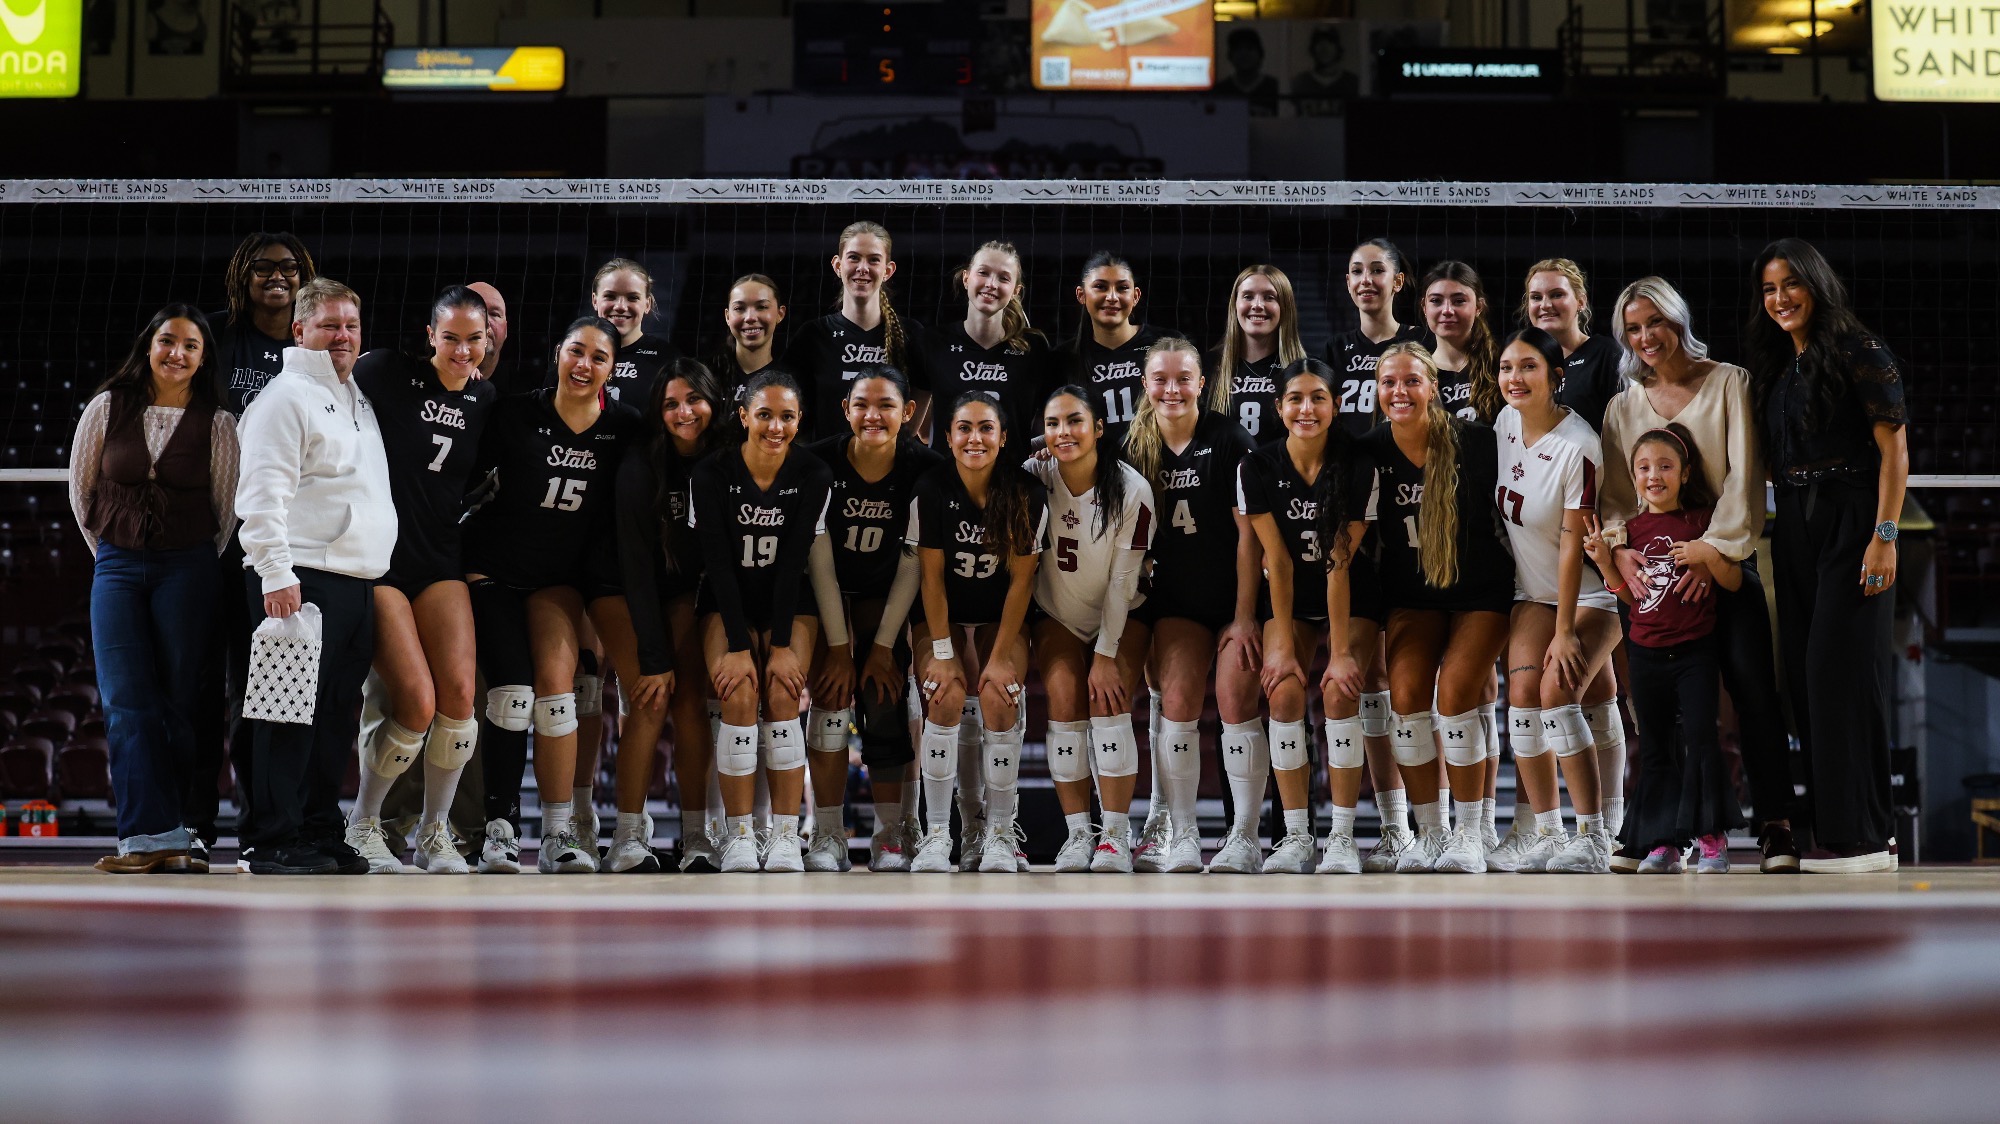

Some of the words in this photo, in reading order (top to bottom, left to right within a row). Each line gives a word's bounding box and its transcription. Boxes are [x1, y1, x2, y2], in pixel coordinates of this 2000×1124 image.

[879, 58, 895, 83] 5
[1421, 63, 1473, 77] UNDER
[1474, 63, 1541, 77] ARMOUR
[77, 184, 118, 194] WHITE
[127, 184, 168, 194] SANDS
[239, 184, 282, 194] WHITE
[290, 182, 332, 193] SANDS
[402, 184, 444, 194] WHITE
[454, 182, 494, 193] SANDS
[567, 184, 610, 194] WHITE
[619, 184, 662, 194] SANDS
[734, 184, 778, 194] WHITE
[785, 184, 828, 194] SANDS
[900, 184, 942, 194] WHITE
[951, 184, 994, 195] SANDS
[1067, 184, 1110, 195] WHITE
[1233, 186, 1276, 196] WHITE
[1284, 186, 1326, 196] SANDS
[1397, 186, 1440, 197] WHITE
[1449, 186, 1490, 197] SANDS
[1563, 188, 1604, 198] WHITE
[1613, 188, 1654, 199] SANDS
[1726, 188, 1768, 199] WHITE
[1776, 190, 1816, 200] SANDS
[1887, 190, 1928, 201] WHITE
[1937, 192, 1978, 202] SANDS
[960, 361, 1008, 382] State
[1092, 361, 1141, 383] State
[1346, 354, 1377, 372] Sta
[1230, 376, 1276, 394] State
[1442, 383, 1470, 404] Sta
[1103, 387, 1136, 424] 11
[1340, 379, 1376, 413] 28
[421, 400, 465, 429] State
[1239, 401, 1260, 436] 8
[428, 434, 452, 473] 7
[547, 445, 596, 470] State
[1158, 468, 1200, 490] State
[540, 476, 587, 512] 15
[737, 504, 784, 526] State
[843, 498, 892, 519] State
[1287, 498, 1316, 520] Sta
[1498, 486, 1524, 527] 17
[1172, 500, 1197, 535] 4
[844, 526, 884, 552] 10
[741, 535, 778, 567] 19
[1057, 536, 1078, 573] 5
[954, 552, 998, 579] 33
